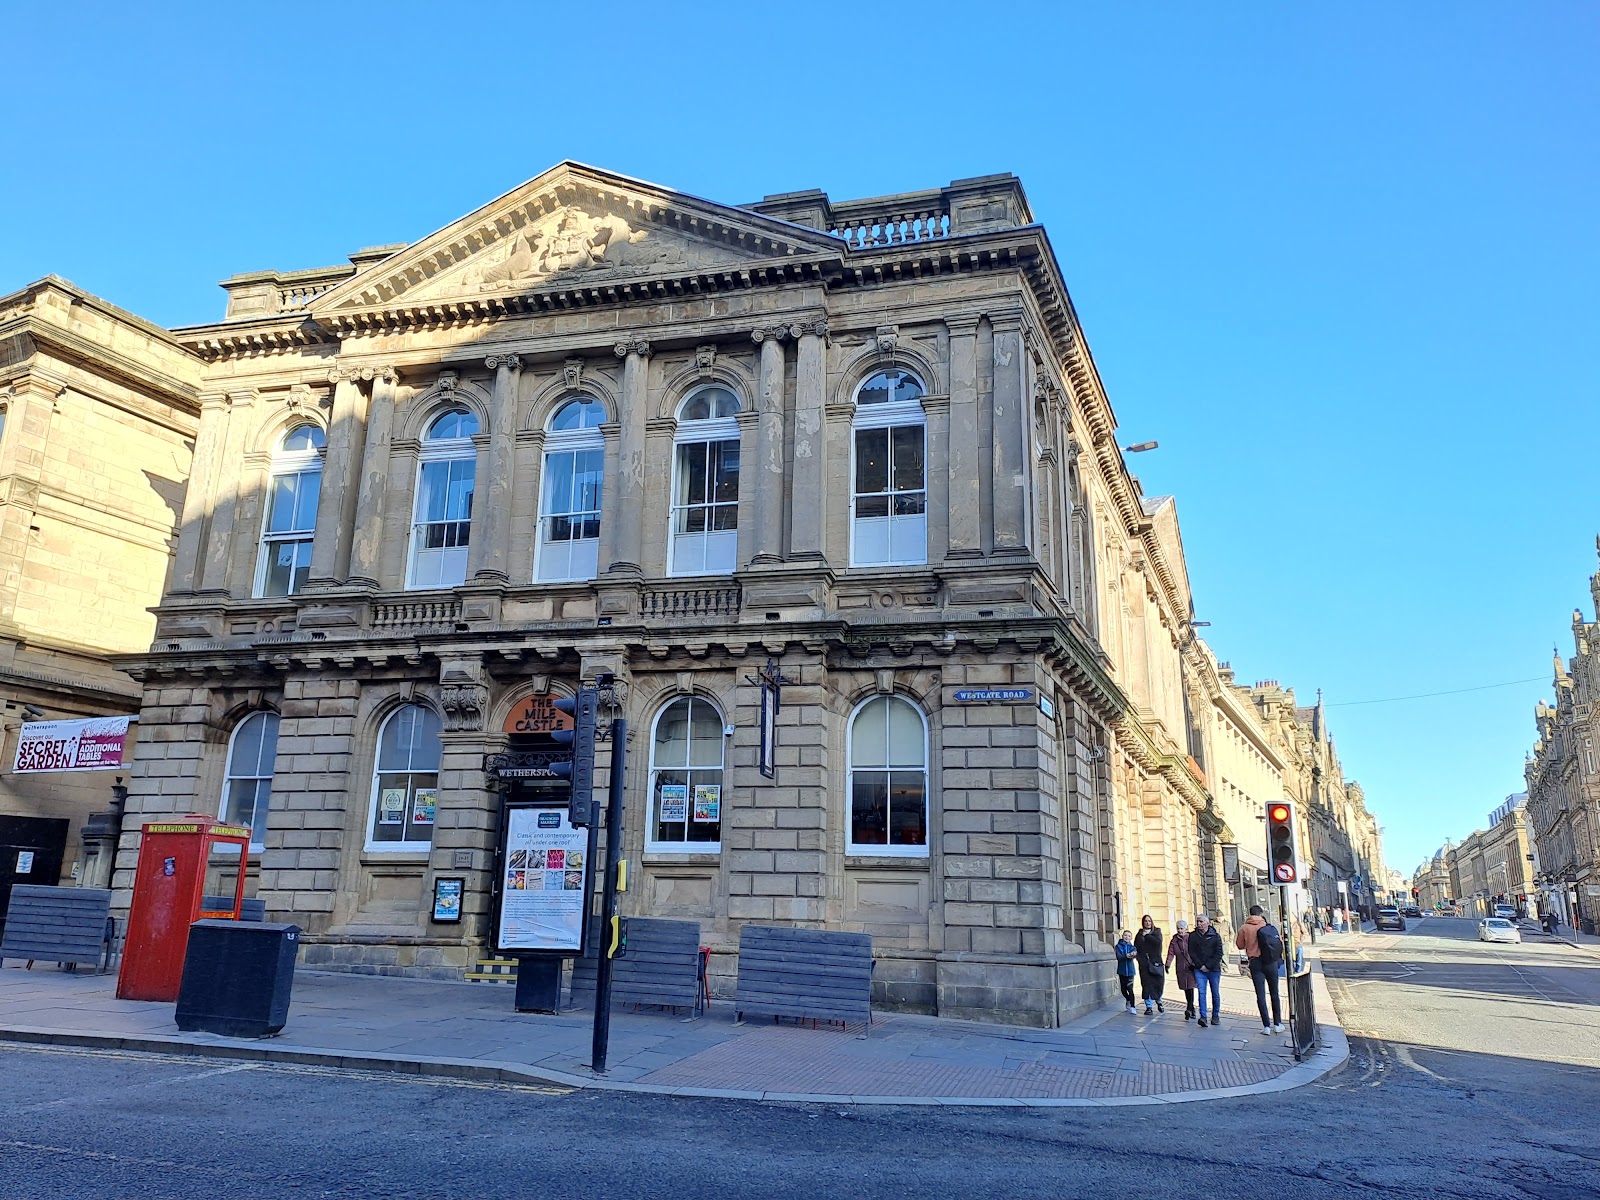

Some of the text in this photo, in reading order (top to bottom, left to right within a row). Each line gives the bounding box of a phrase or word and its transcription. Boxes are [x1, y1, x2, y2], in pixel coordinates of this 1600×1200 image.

[530, 698, 552, 708] THE
[524, 708, 556, 720] MILE
[516, 720, 564, 731] CASTLE
[20, 740, 67, 756] SECRET
[80, 743, 121, 752] ADDITIONAL
[17, 754, 71, 769] GARDEN
[78, 752, 102, 761] TABLES
